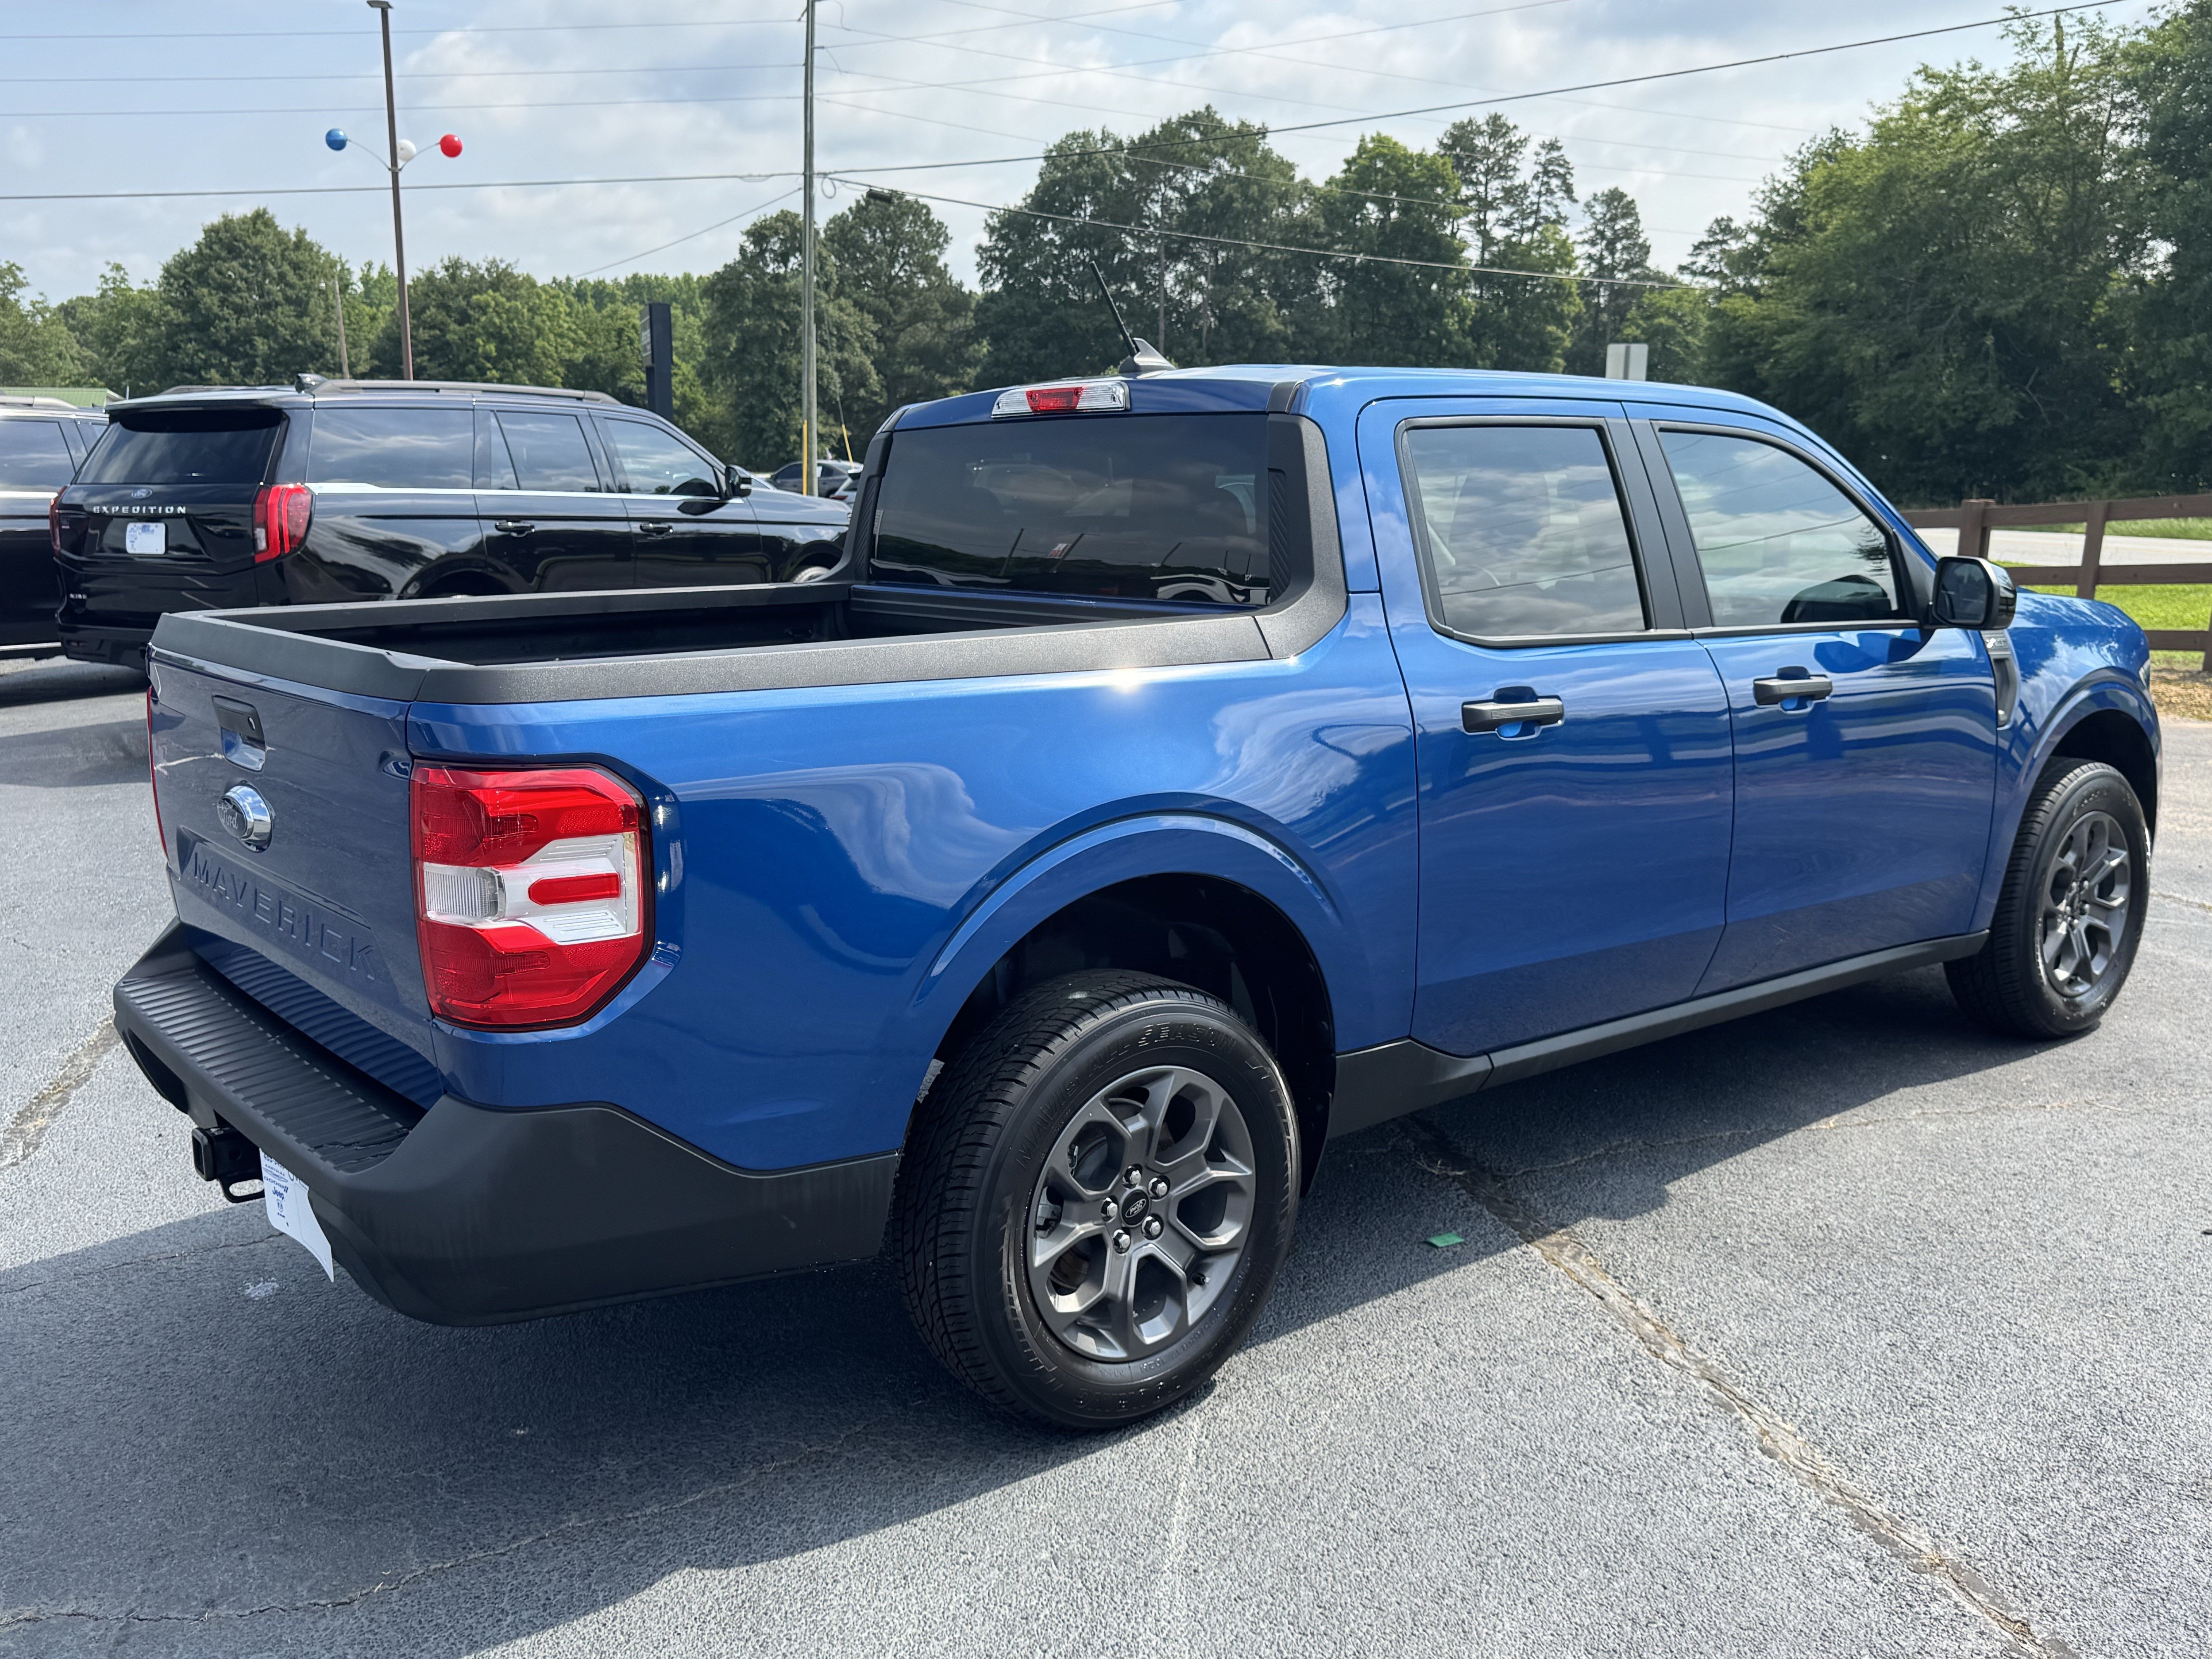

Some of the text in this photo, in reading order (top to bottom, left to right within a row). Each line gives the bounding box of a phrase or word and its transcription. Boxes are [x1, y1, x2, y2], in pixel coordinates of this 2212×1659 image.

[93, 506, 186, 514] EXPEDITION
[194, 852, 375, 980] MAVERICK
[1015, 1076, 1080, 1169] MAVIS
[1087, 1043, 1131, 1078] ALL
[1138, 1021, 1237, 1054] SEASON
